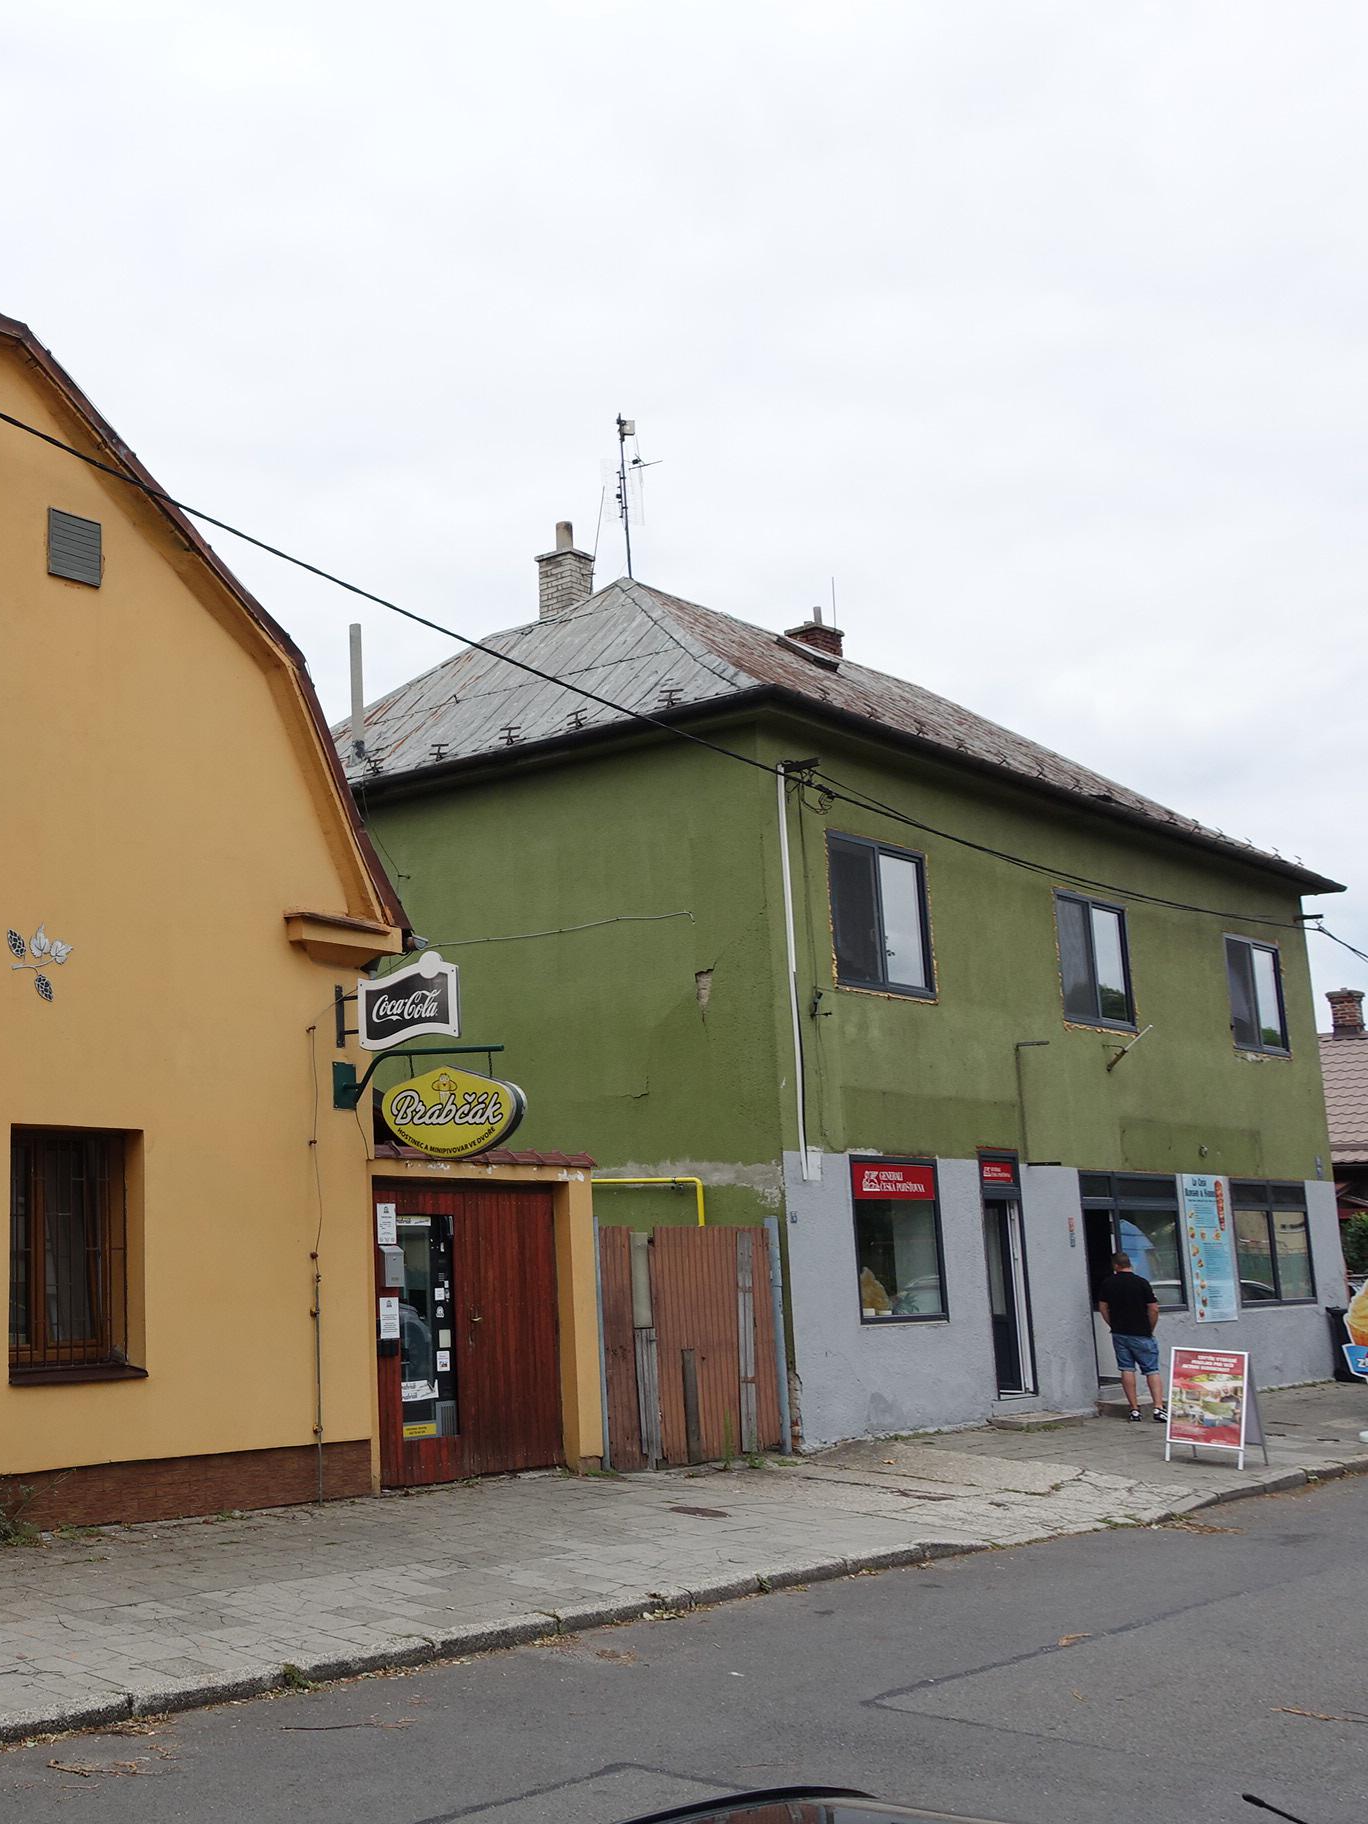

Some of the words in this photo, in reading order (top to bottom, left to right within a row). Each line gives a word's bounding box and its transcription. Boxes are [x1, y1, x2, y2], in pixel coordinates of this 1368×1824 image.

[372, 989, 442, 1023] Coca-Cola
[391, 1089, 504, 1126] Brabčák
[397, 1127, 425, 1149] HOSTINEC
[468, 1140, 477, 1149] VE
